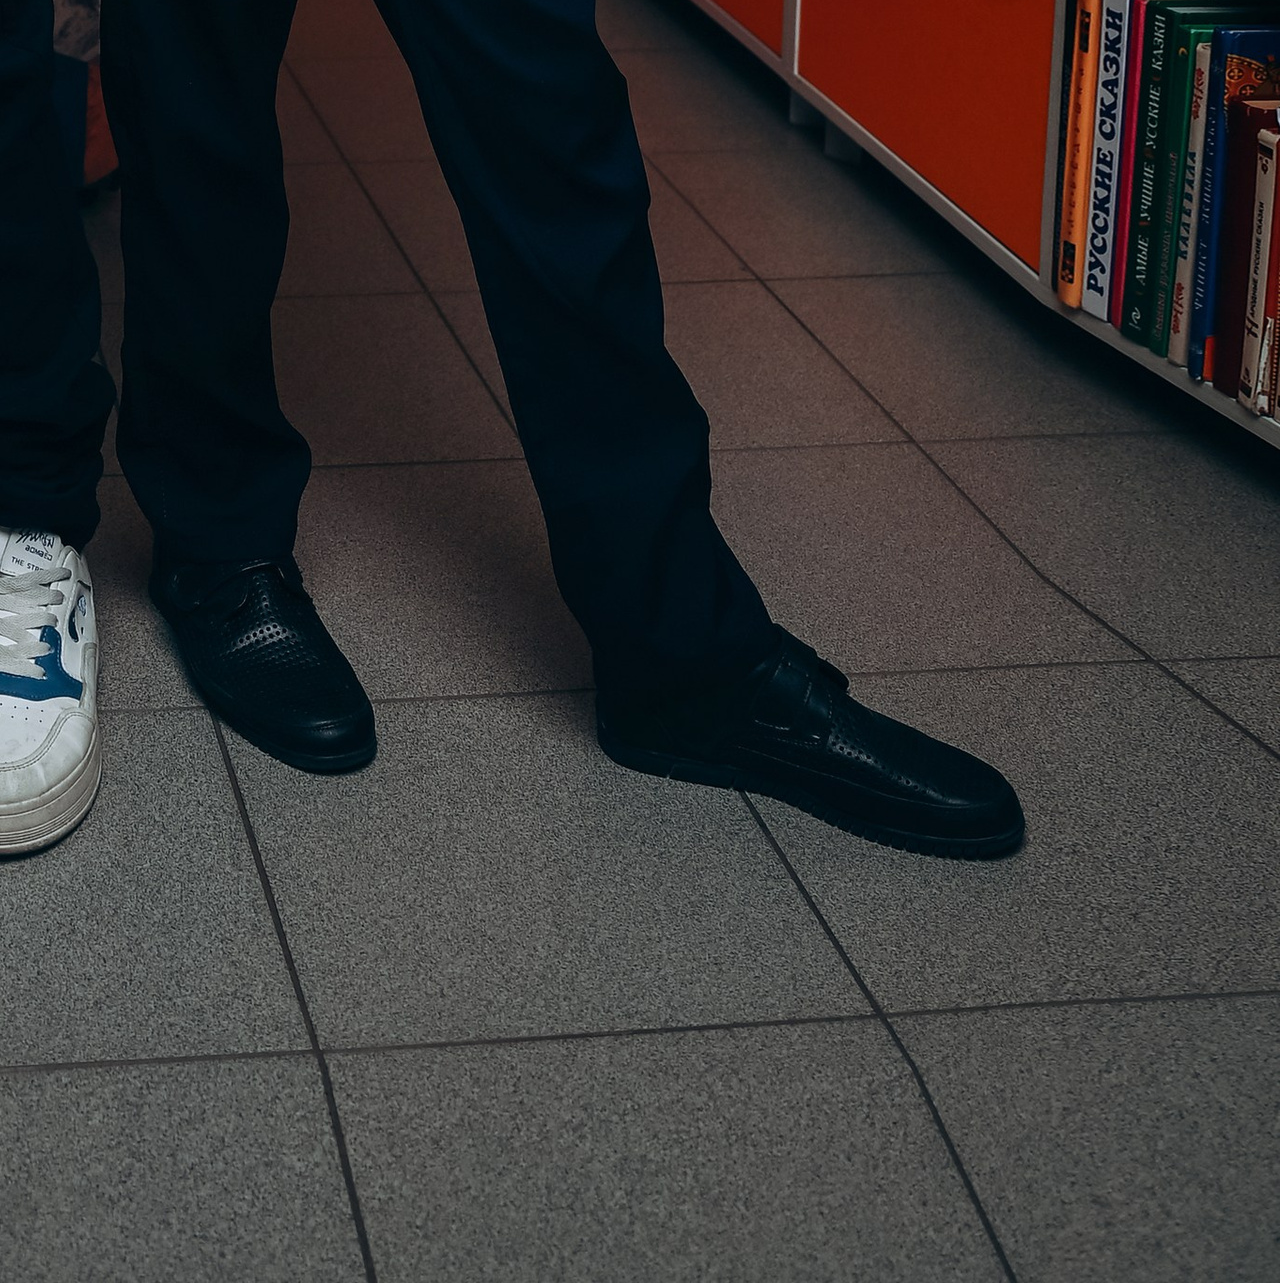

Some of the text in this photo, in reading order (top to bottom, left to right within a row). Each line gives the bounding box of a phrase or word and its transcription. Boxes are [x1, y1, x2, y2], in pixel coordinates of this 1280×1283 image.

[1086, 128, 1114, 277] РУССКИЕ
[1177, 150, 1197, 261] КАЛЕВАЛА
[1256, 201, 1266, 236] СКАЗКИ
[1253, 237, 1264, 276] РУССКИЕ
[11, 555, 25, 567] THE
